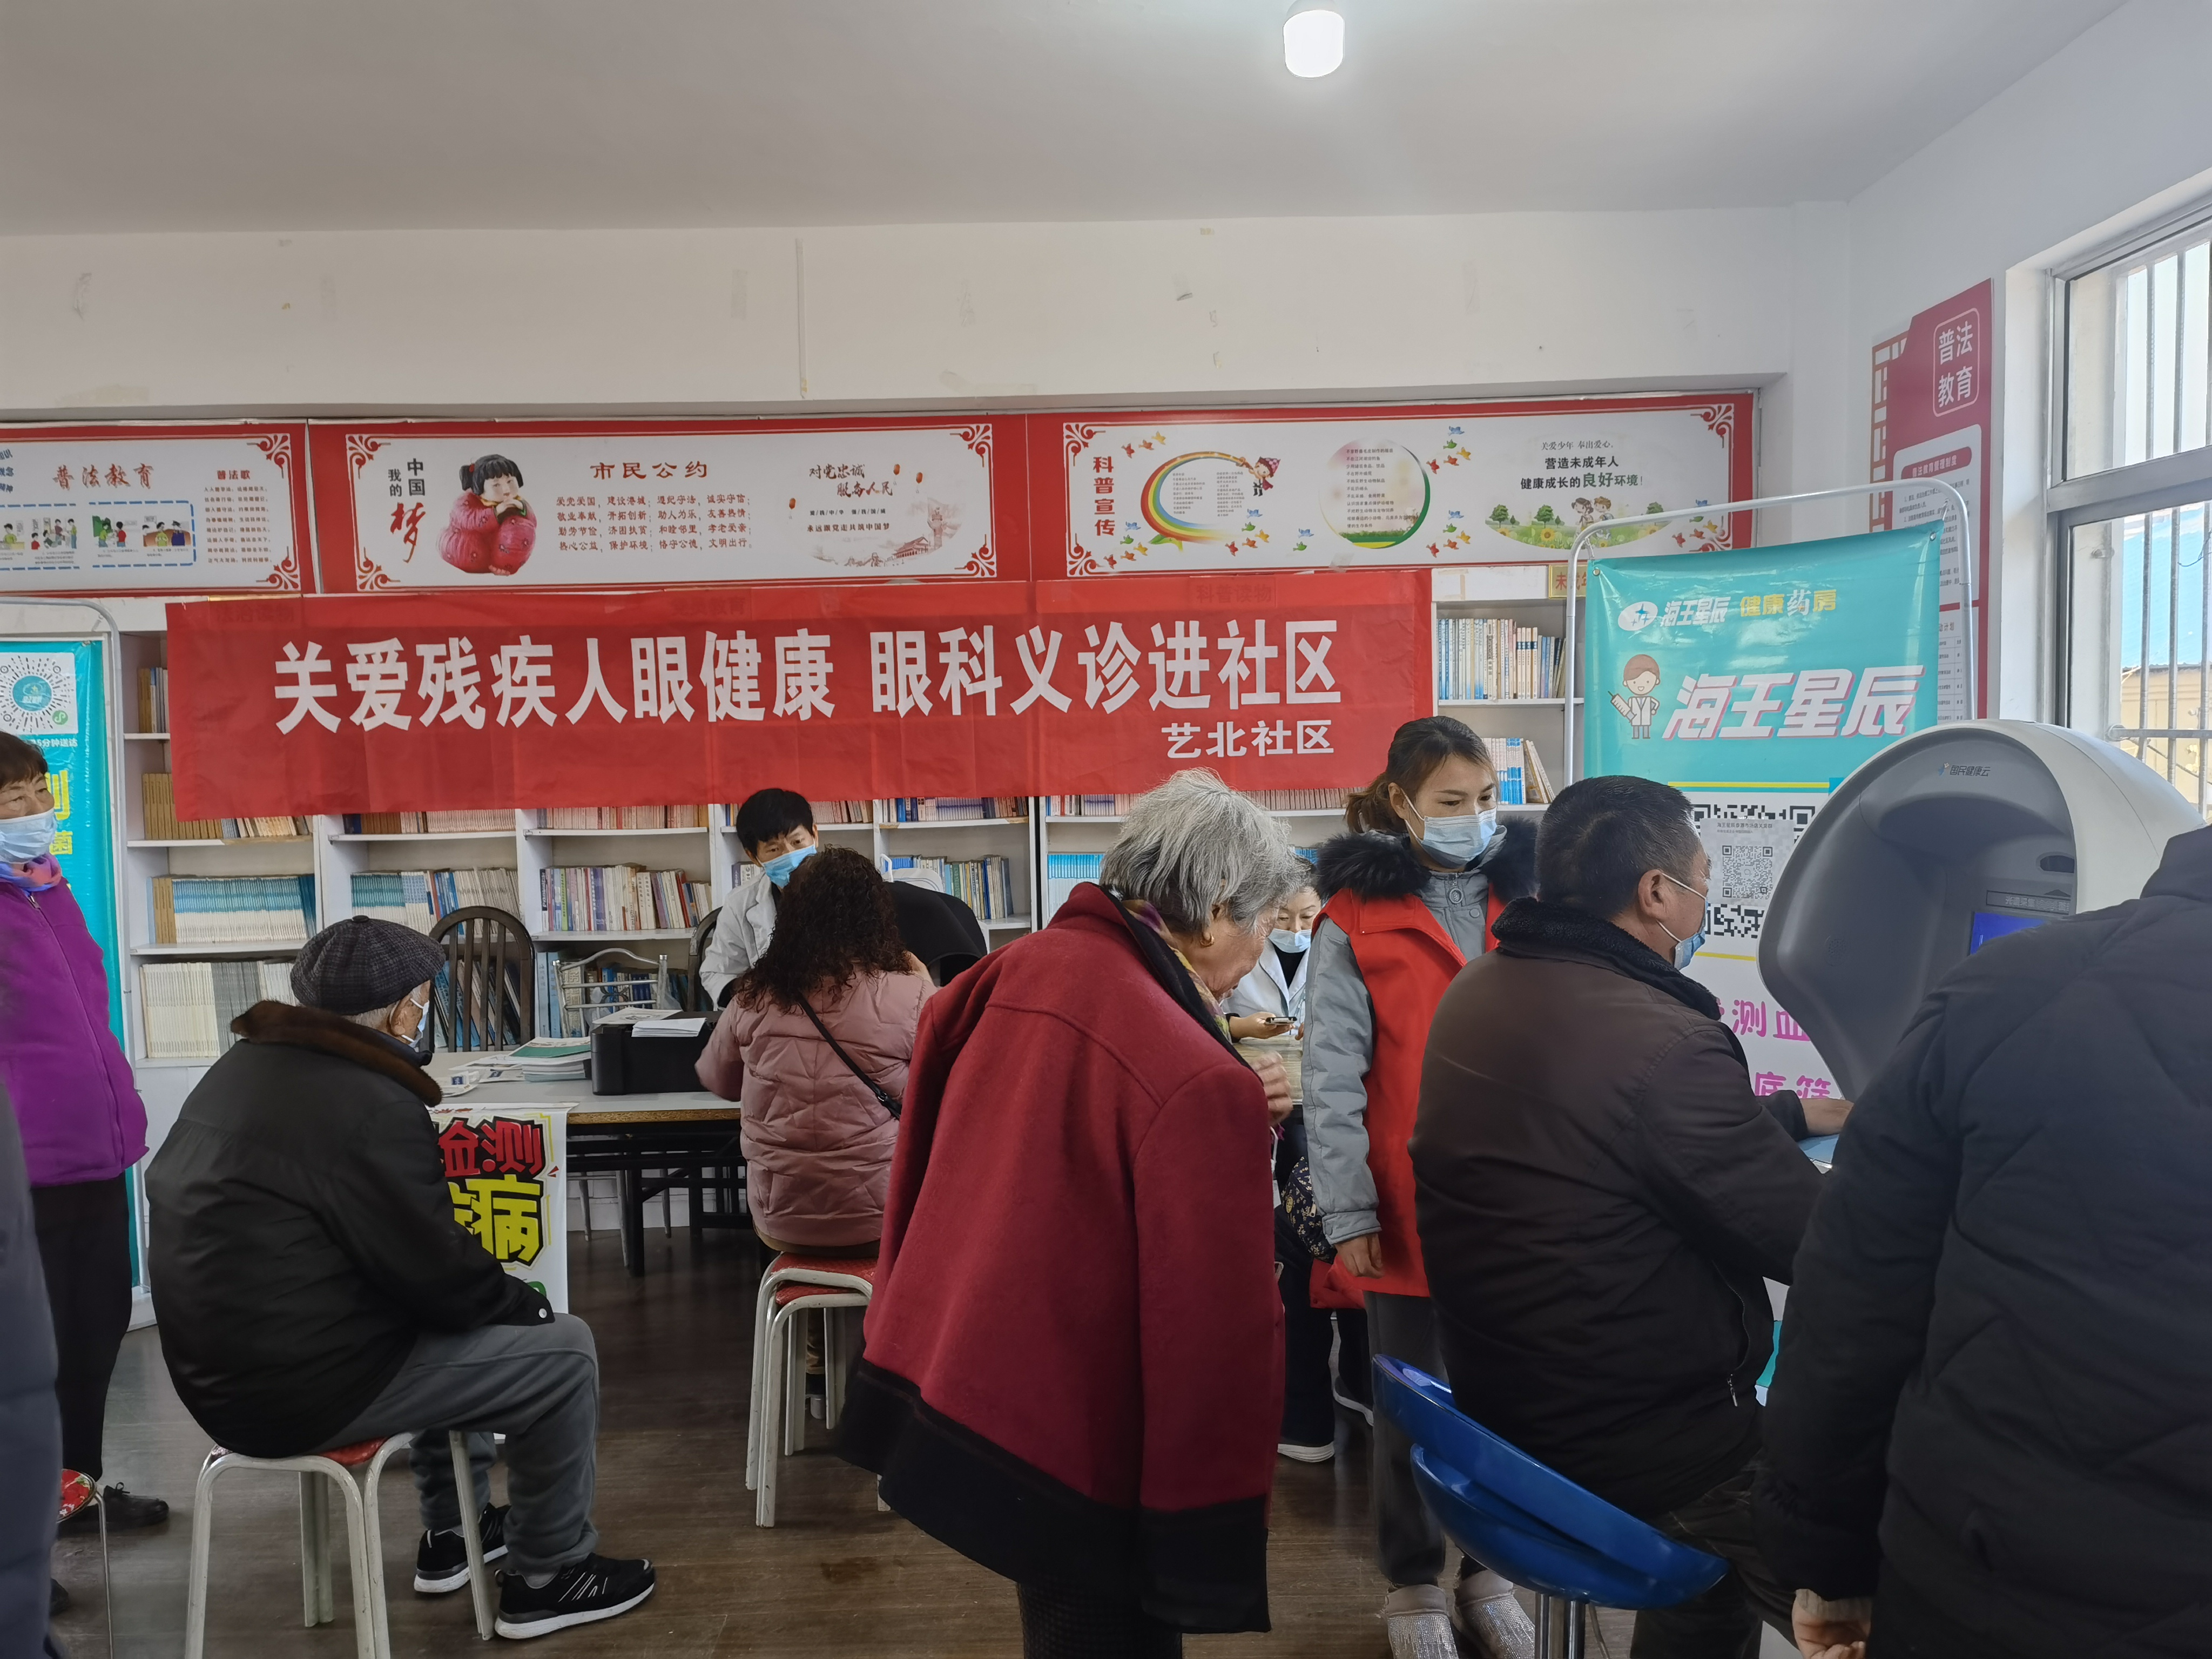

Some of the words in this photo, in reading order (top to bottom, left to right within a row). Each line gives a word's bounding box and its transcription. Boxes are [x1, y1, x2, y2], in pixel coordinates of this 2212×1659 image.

[52, 463, 154, 491] 普法教育
[407, 458, 426, 496] 中国
[590, 461, 707, 480] 市民公约
[809, 463, 865, 480] 对党忠诚
[1545, 455, 1619, 470] 营造未成年人
[388, 468, 402, 497] 我的
[837, 481, 893, 498] 服务人民
[1092, 456, 1116, 536] 科普宣传
[1660, 596, 1731, 627] 海王星辰
[1739, 589, 1837, 617] 健康药房
[274, 628, 837, 735] 关爱残疾人眼健康
[869, 618, 1341, 718] 眼科义诊进社区
[1661, 664, 1926, 741] 海王星辰
[1161, 719, 1334, 759] 艺北社区
[1950, 765, 1991, 777] 国民健康云
